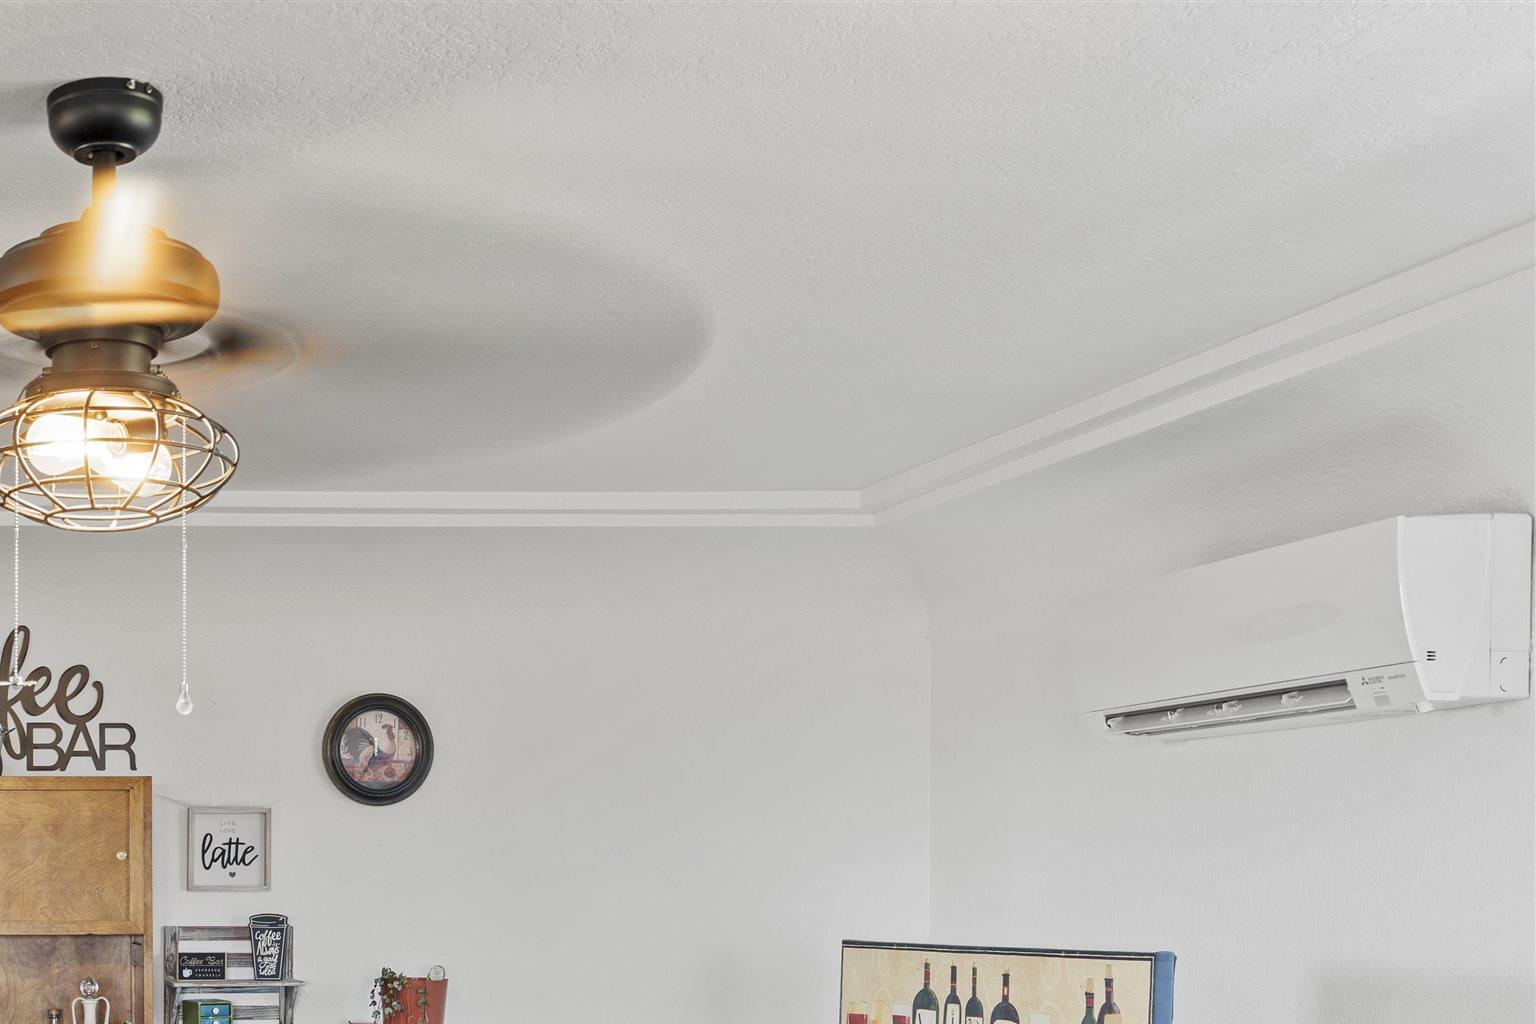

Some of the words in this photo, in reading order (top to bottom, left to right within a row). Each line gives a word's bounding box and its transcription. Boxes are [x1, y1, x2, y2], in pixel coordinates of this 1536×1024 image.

[26, 722, 138, 771] BAR
[201, 832, 259, 870] latte
[254, 930, 282, 946] Coffee
